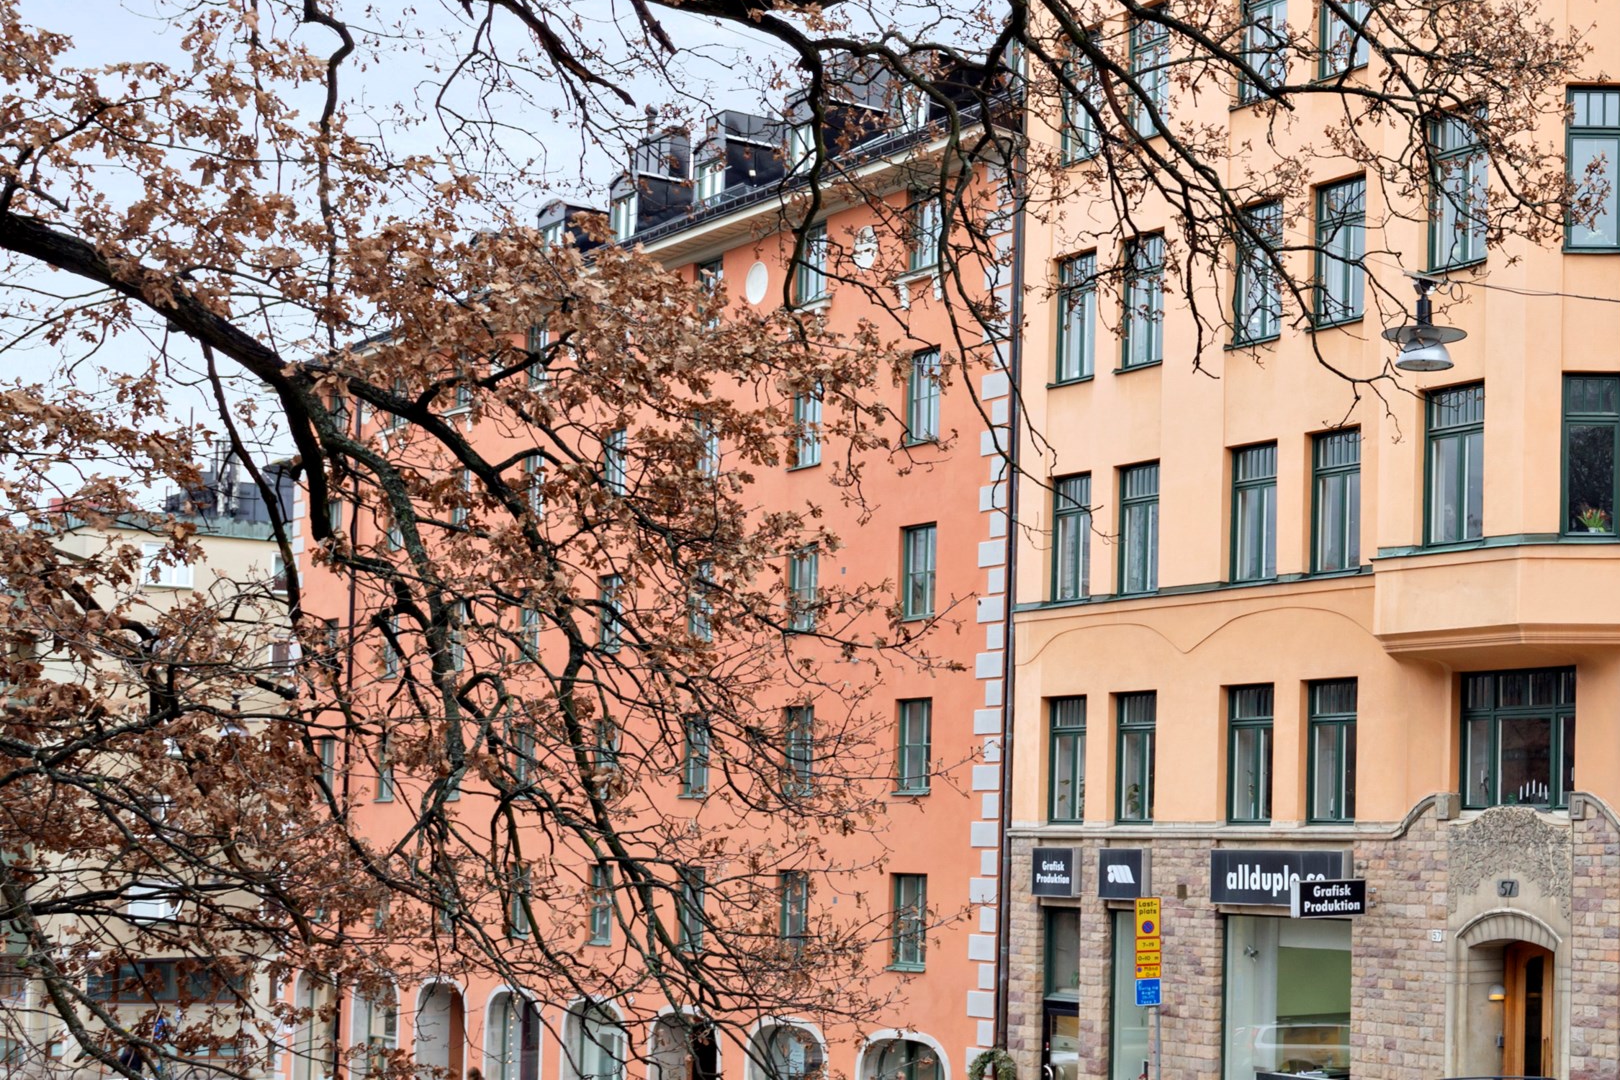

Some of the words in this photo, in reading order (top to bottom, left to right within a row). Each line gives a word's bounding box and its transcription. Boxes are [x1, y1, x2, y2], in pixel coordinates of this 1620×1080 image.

[1042, 861, 1065, 871] Grafisk
[1036, 873, 1070, 884] Produktion
[1226, 864, 1326, 897] alldupl
[1313, 884, 1351, 897] Grafisk
[1501, 881, 1515, 896] 57
[1304, 899, 1360, 912] Produktion
